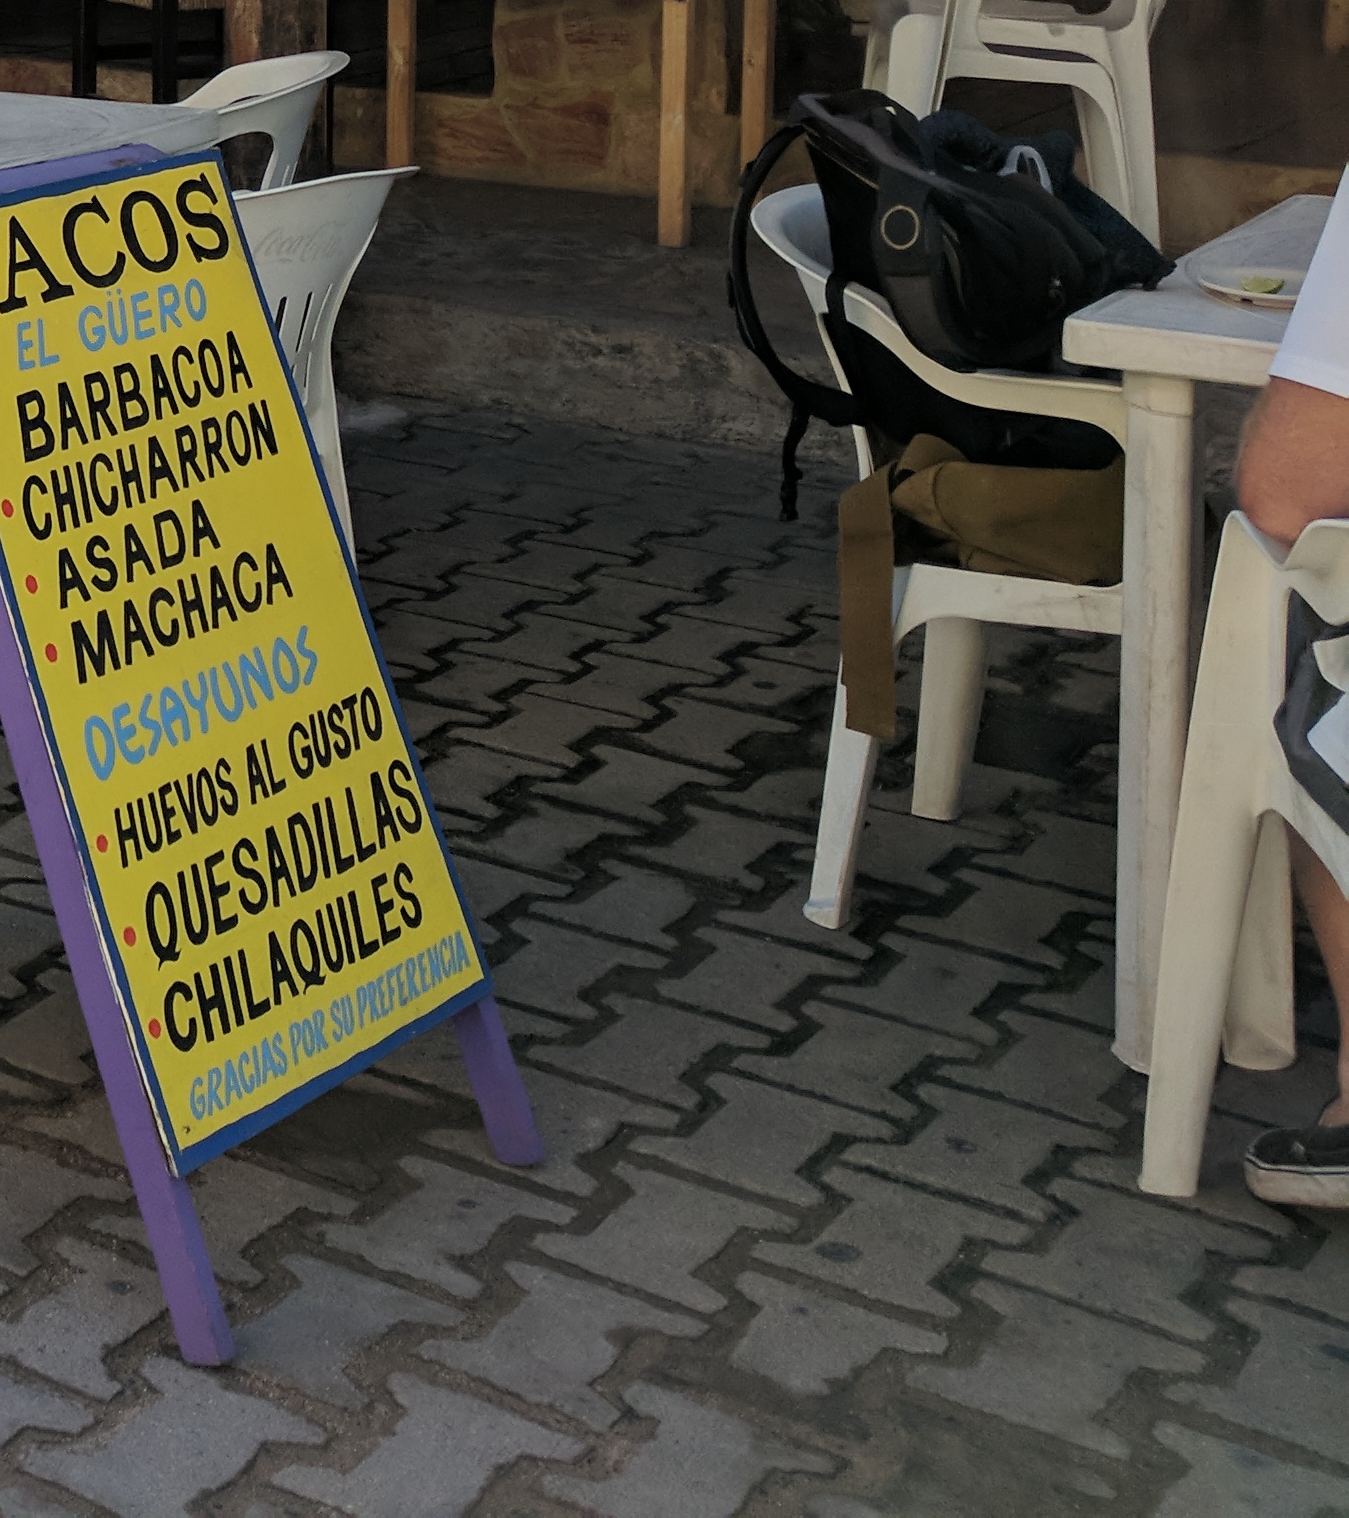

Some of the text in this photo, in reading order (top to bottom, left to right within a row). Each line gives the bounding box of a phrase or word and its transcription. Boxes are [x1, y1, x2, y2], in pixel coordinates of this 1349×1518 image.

[16, 331, 253, 463] BARBACOA
[17, 278, 208, 371] EL GÜERO
[22, 399, 279, 542] CHICHARRON
[58, 499, 221, 609] ASADA
[72, 544, 293, 684] MACHACA
[83, 626, 319, 781] DESAYUNOS
[113, 686, 383, 869] HUEVOS AL GUSTO
[144, 758, 423, 969] QUESADILLAS
[163, 862, 423, 1052] CHILAQUILES
[189, 931, 471, 1121] GRACIAS POR SU PREFERENCIA
